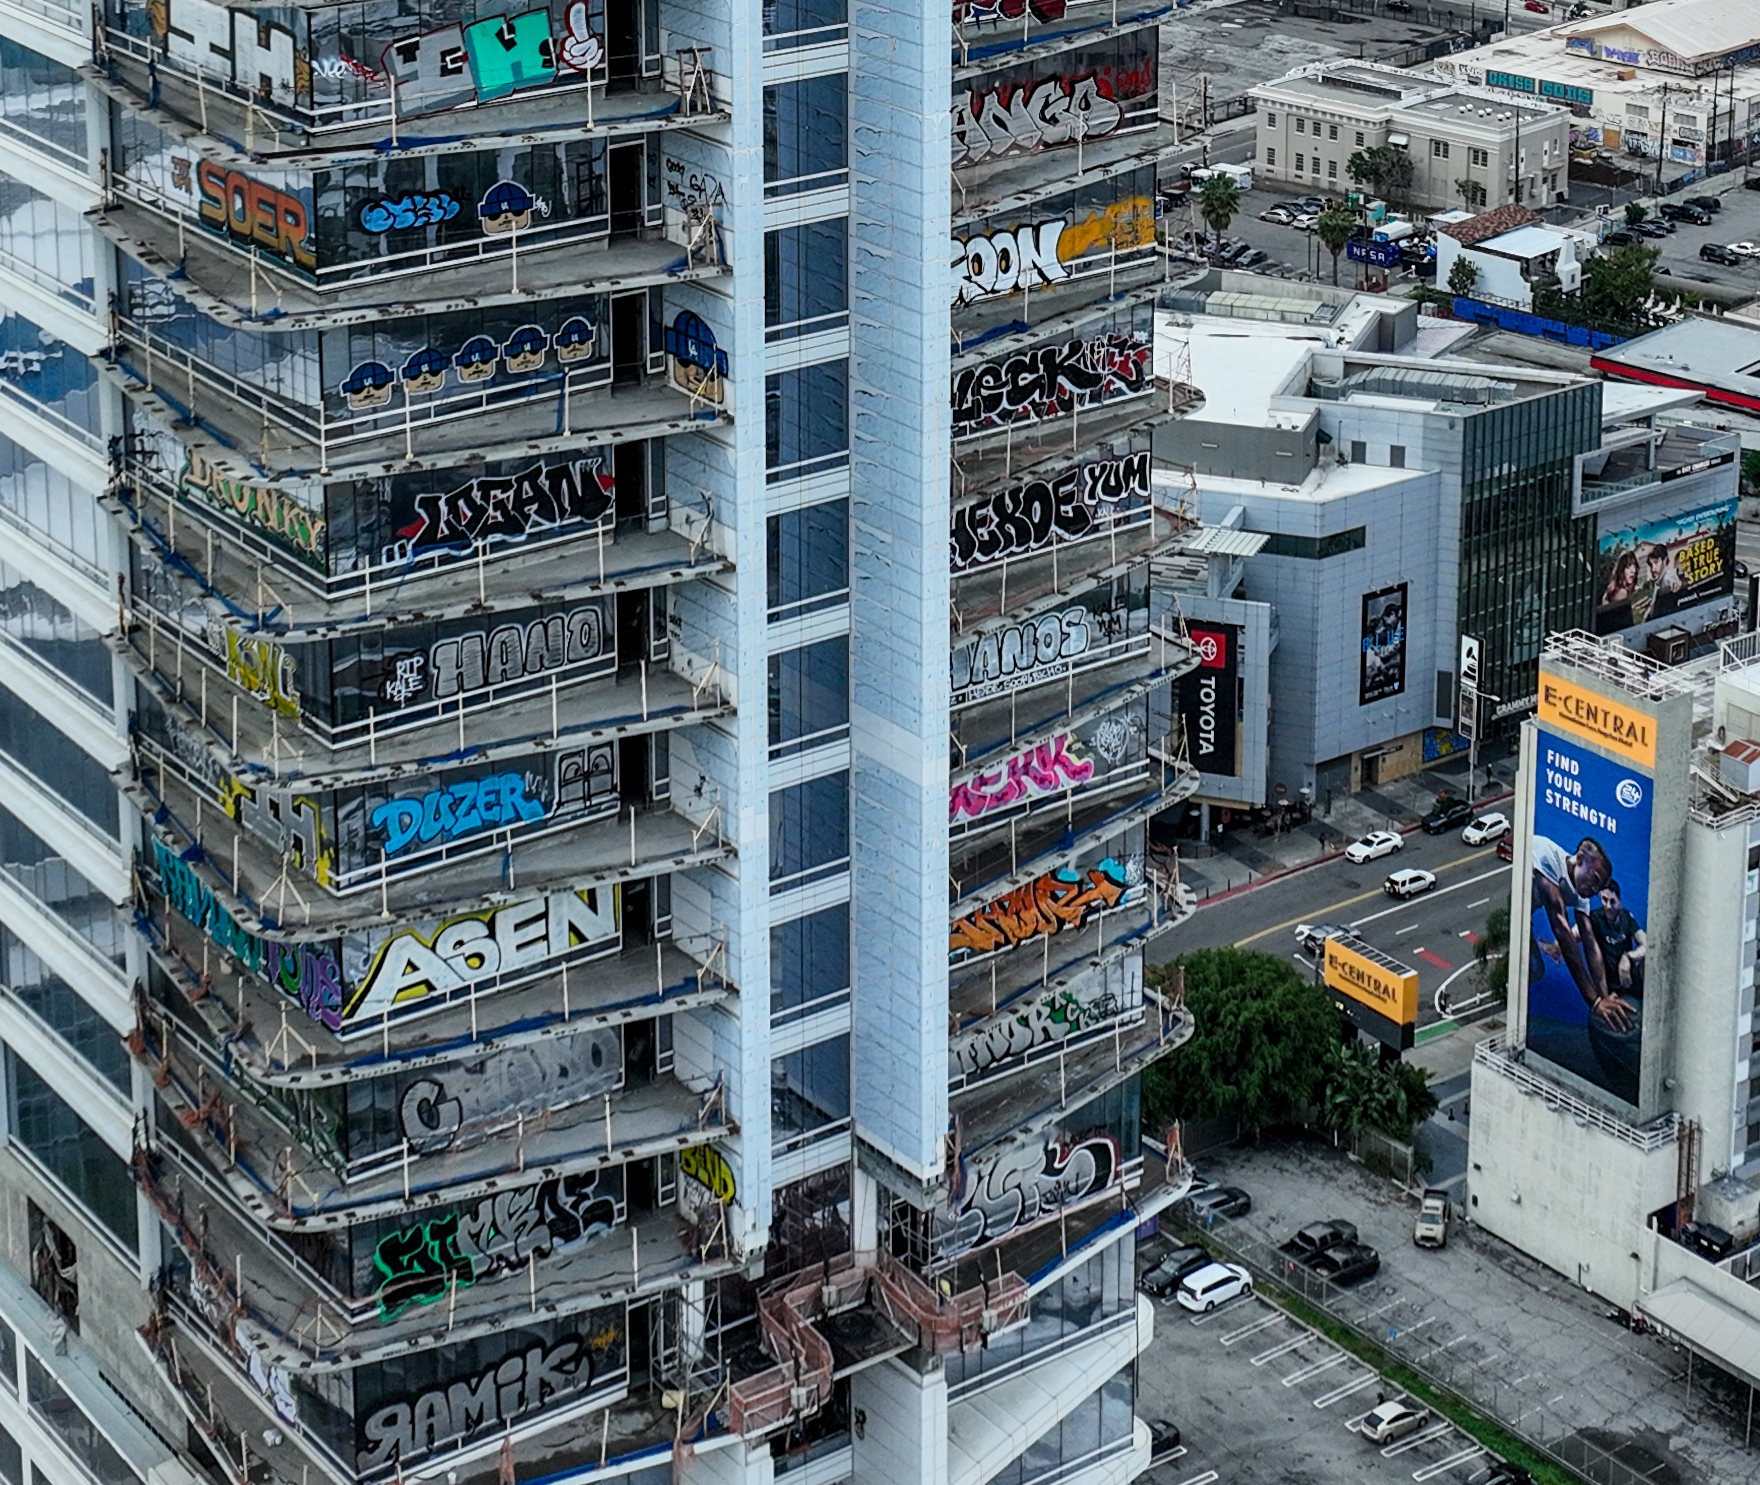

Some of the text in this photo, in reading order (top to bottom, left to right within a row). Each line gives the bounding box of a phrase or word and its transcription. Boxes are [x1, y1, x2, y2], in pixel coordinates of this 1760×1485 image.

[1084, 451, 1151, 506] YUM
[1678, 537, 1715, 562] BASED
[1693, 546, 1720, 569] TRUE
[1687, 559, 1724, 584] STORY
[1198, 676, 1216, 756] TOYOTA
[1546, 749, 1580, 776] FIND
[1546, 768, 1582, 798] YOUR
[1545, 789, 1617, 834] STRENGTH
